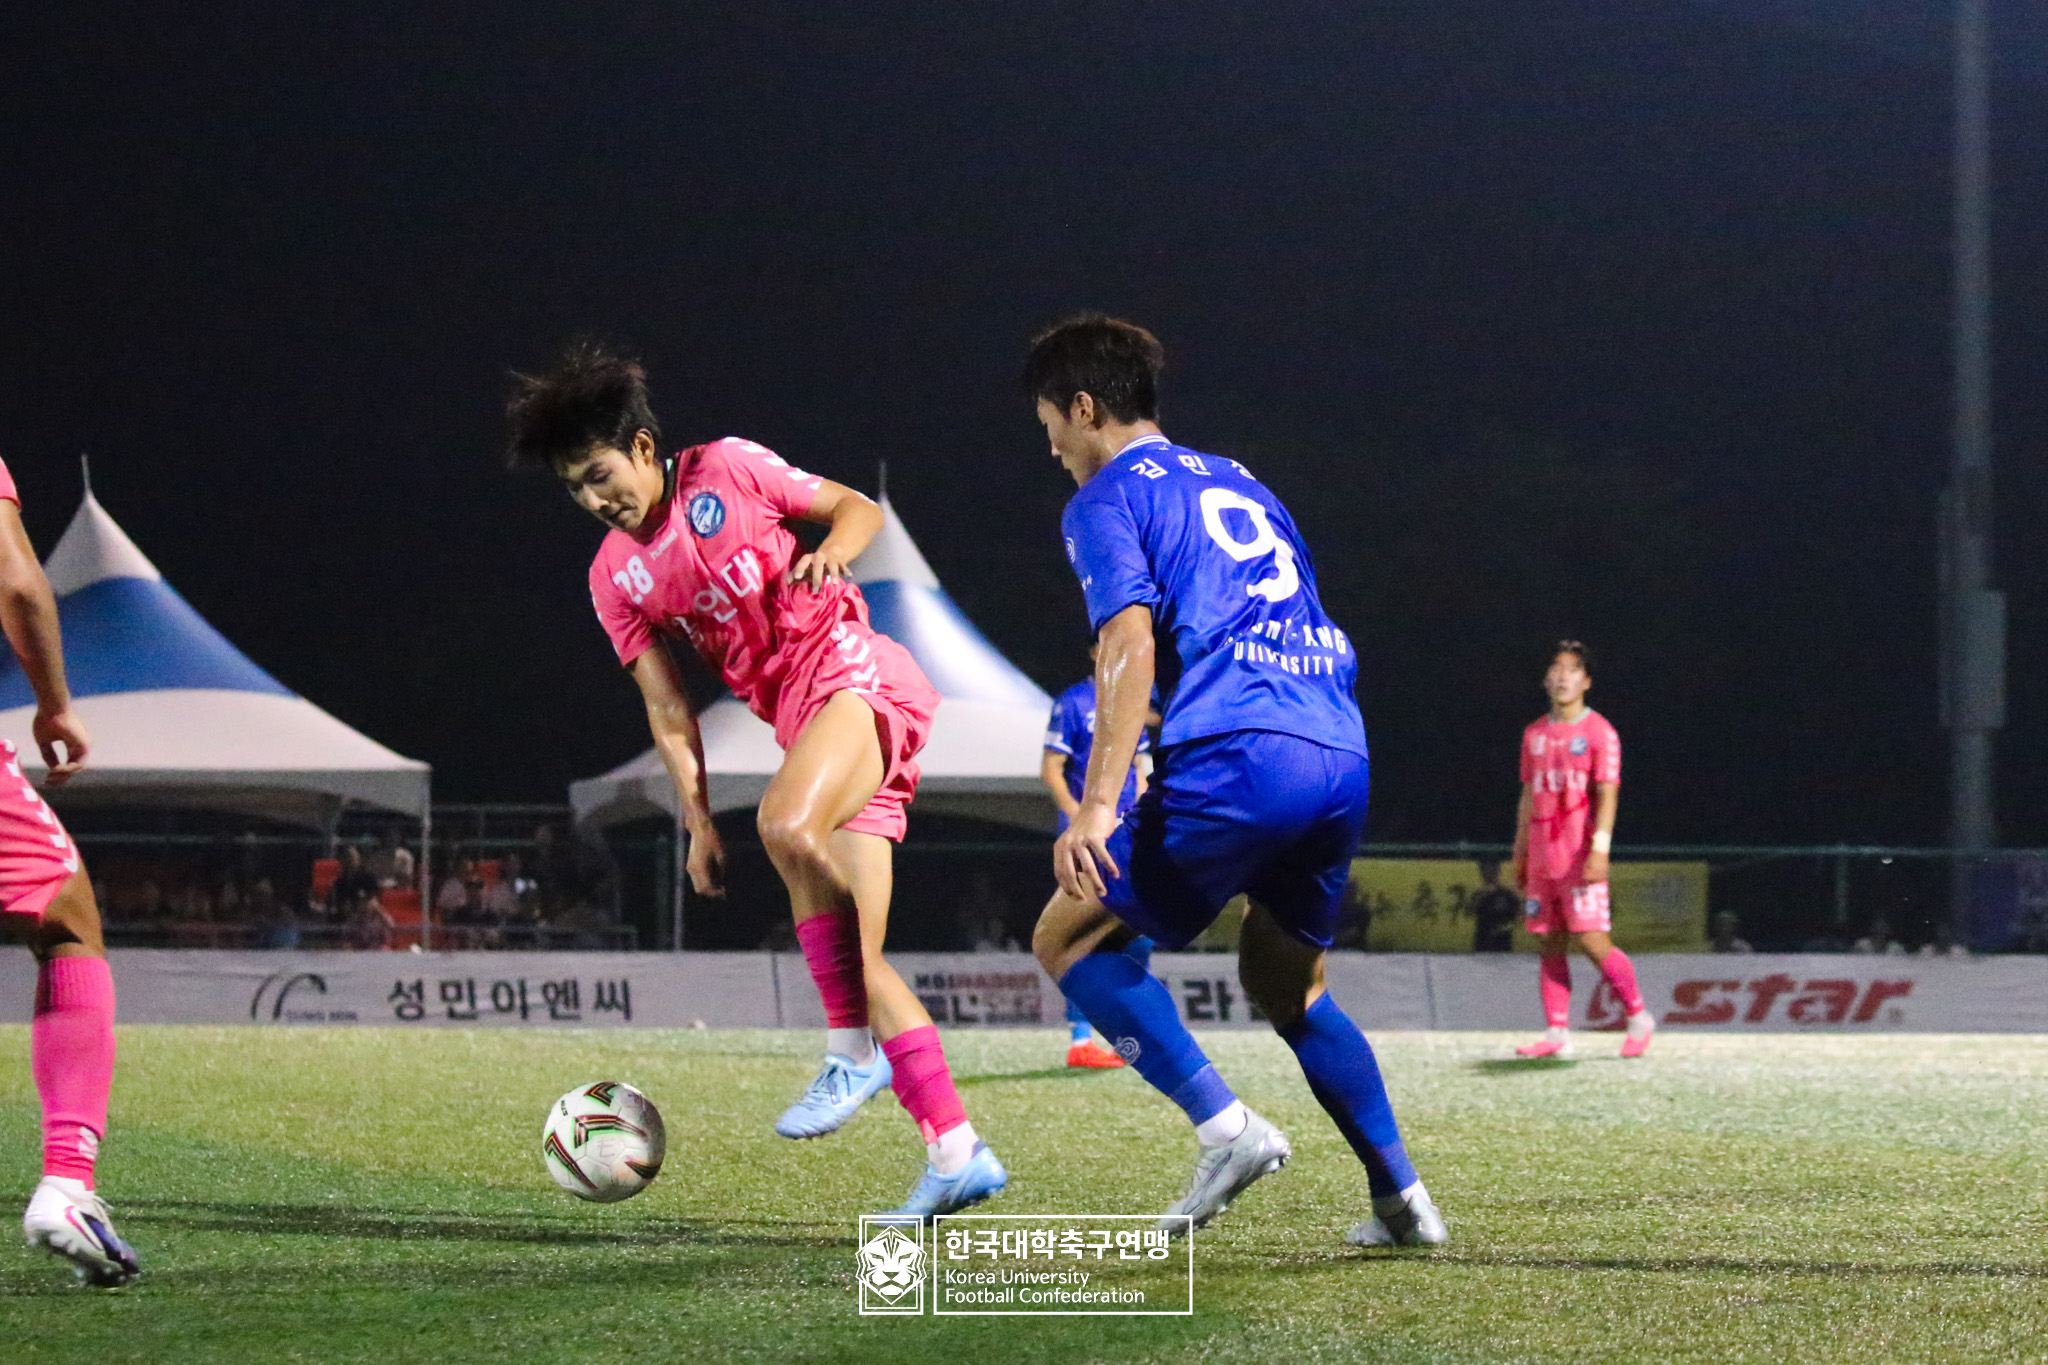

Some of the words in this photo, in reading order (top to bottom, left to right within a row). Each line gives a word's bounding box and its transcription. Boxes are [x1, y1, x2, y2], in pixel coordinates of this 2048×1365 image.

[1200, 488, 1298, 602] 9
[613, 555, 655, 605] 28
[674, 548, 764, 641] 인대
[388, 978, 632, 1021] 성민이엔씨
[1664, 973, 1914, 1023] star
